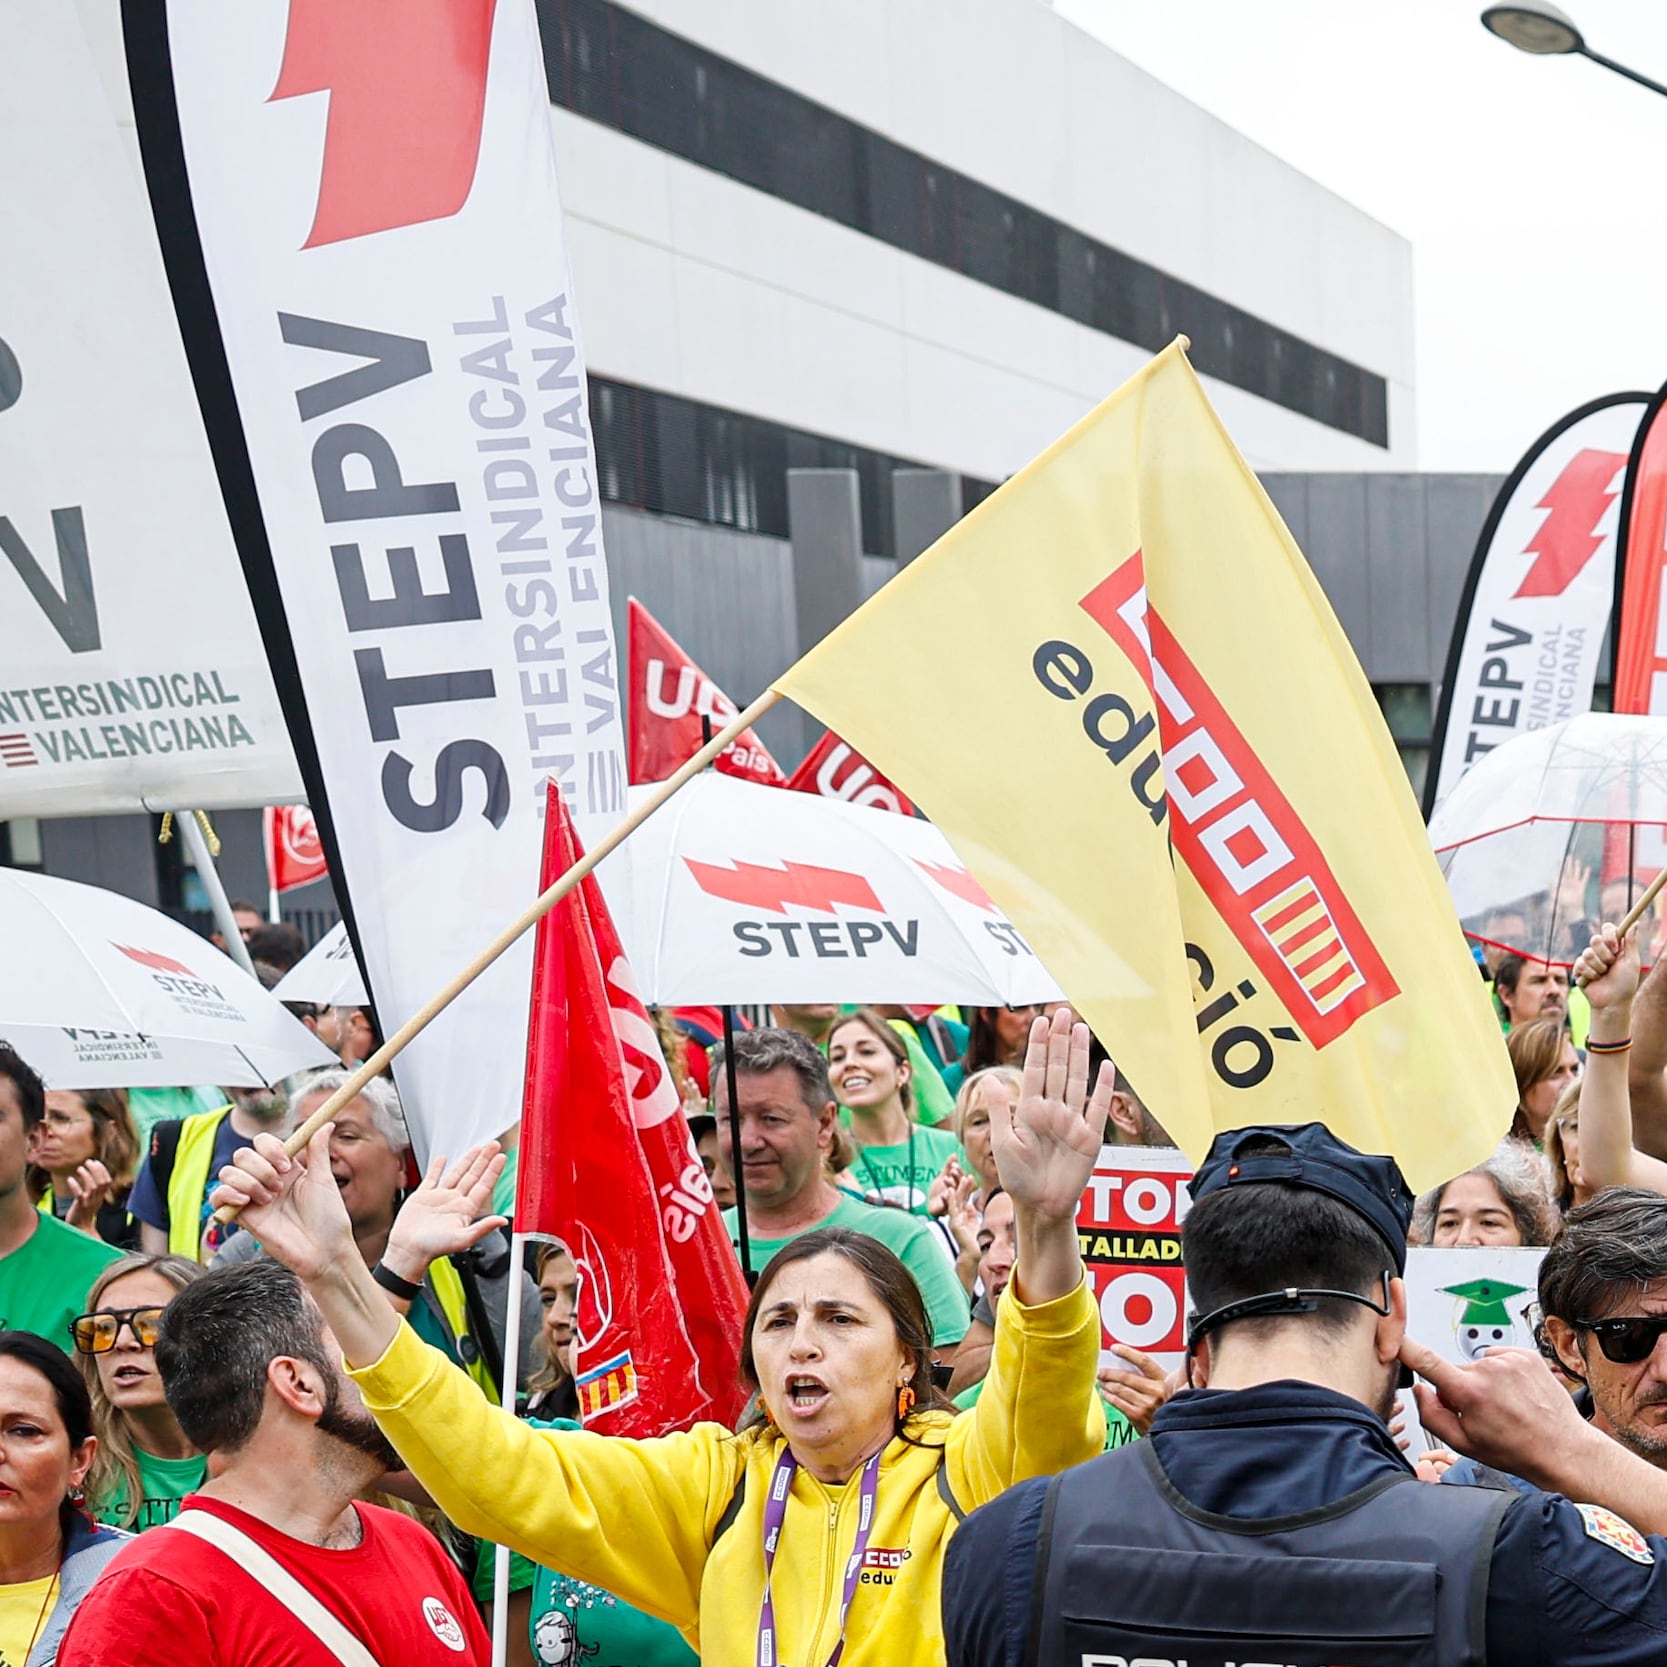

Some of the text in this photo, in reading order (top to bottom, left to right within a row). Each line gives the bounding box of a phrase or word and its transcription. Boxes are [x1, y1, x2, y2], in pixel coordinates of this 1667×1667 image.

[277, 310, 511, 833] STEPV
[0, 670, 240, 725] NTERSINDICAL
[1464, 617, 1533, 764] TEPV
[35, 714, 256, 763] VALENCIANA
[732, 918, 920, 958] STEPV
[152, 973, 225, 1001] STEPV
